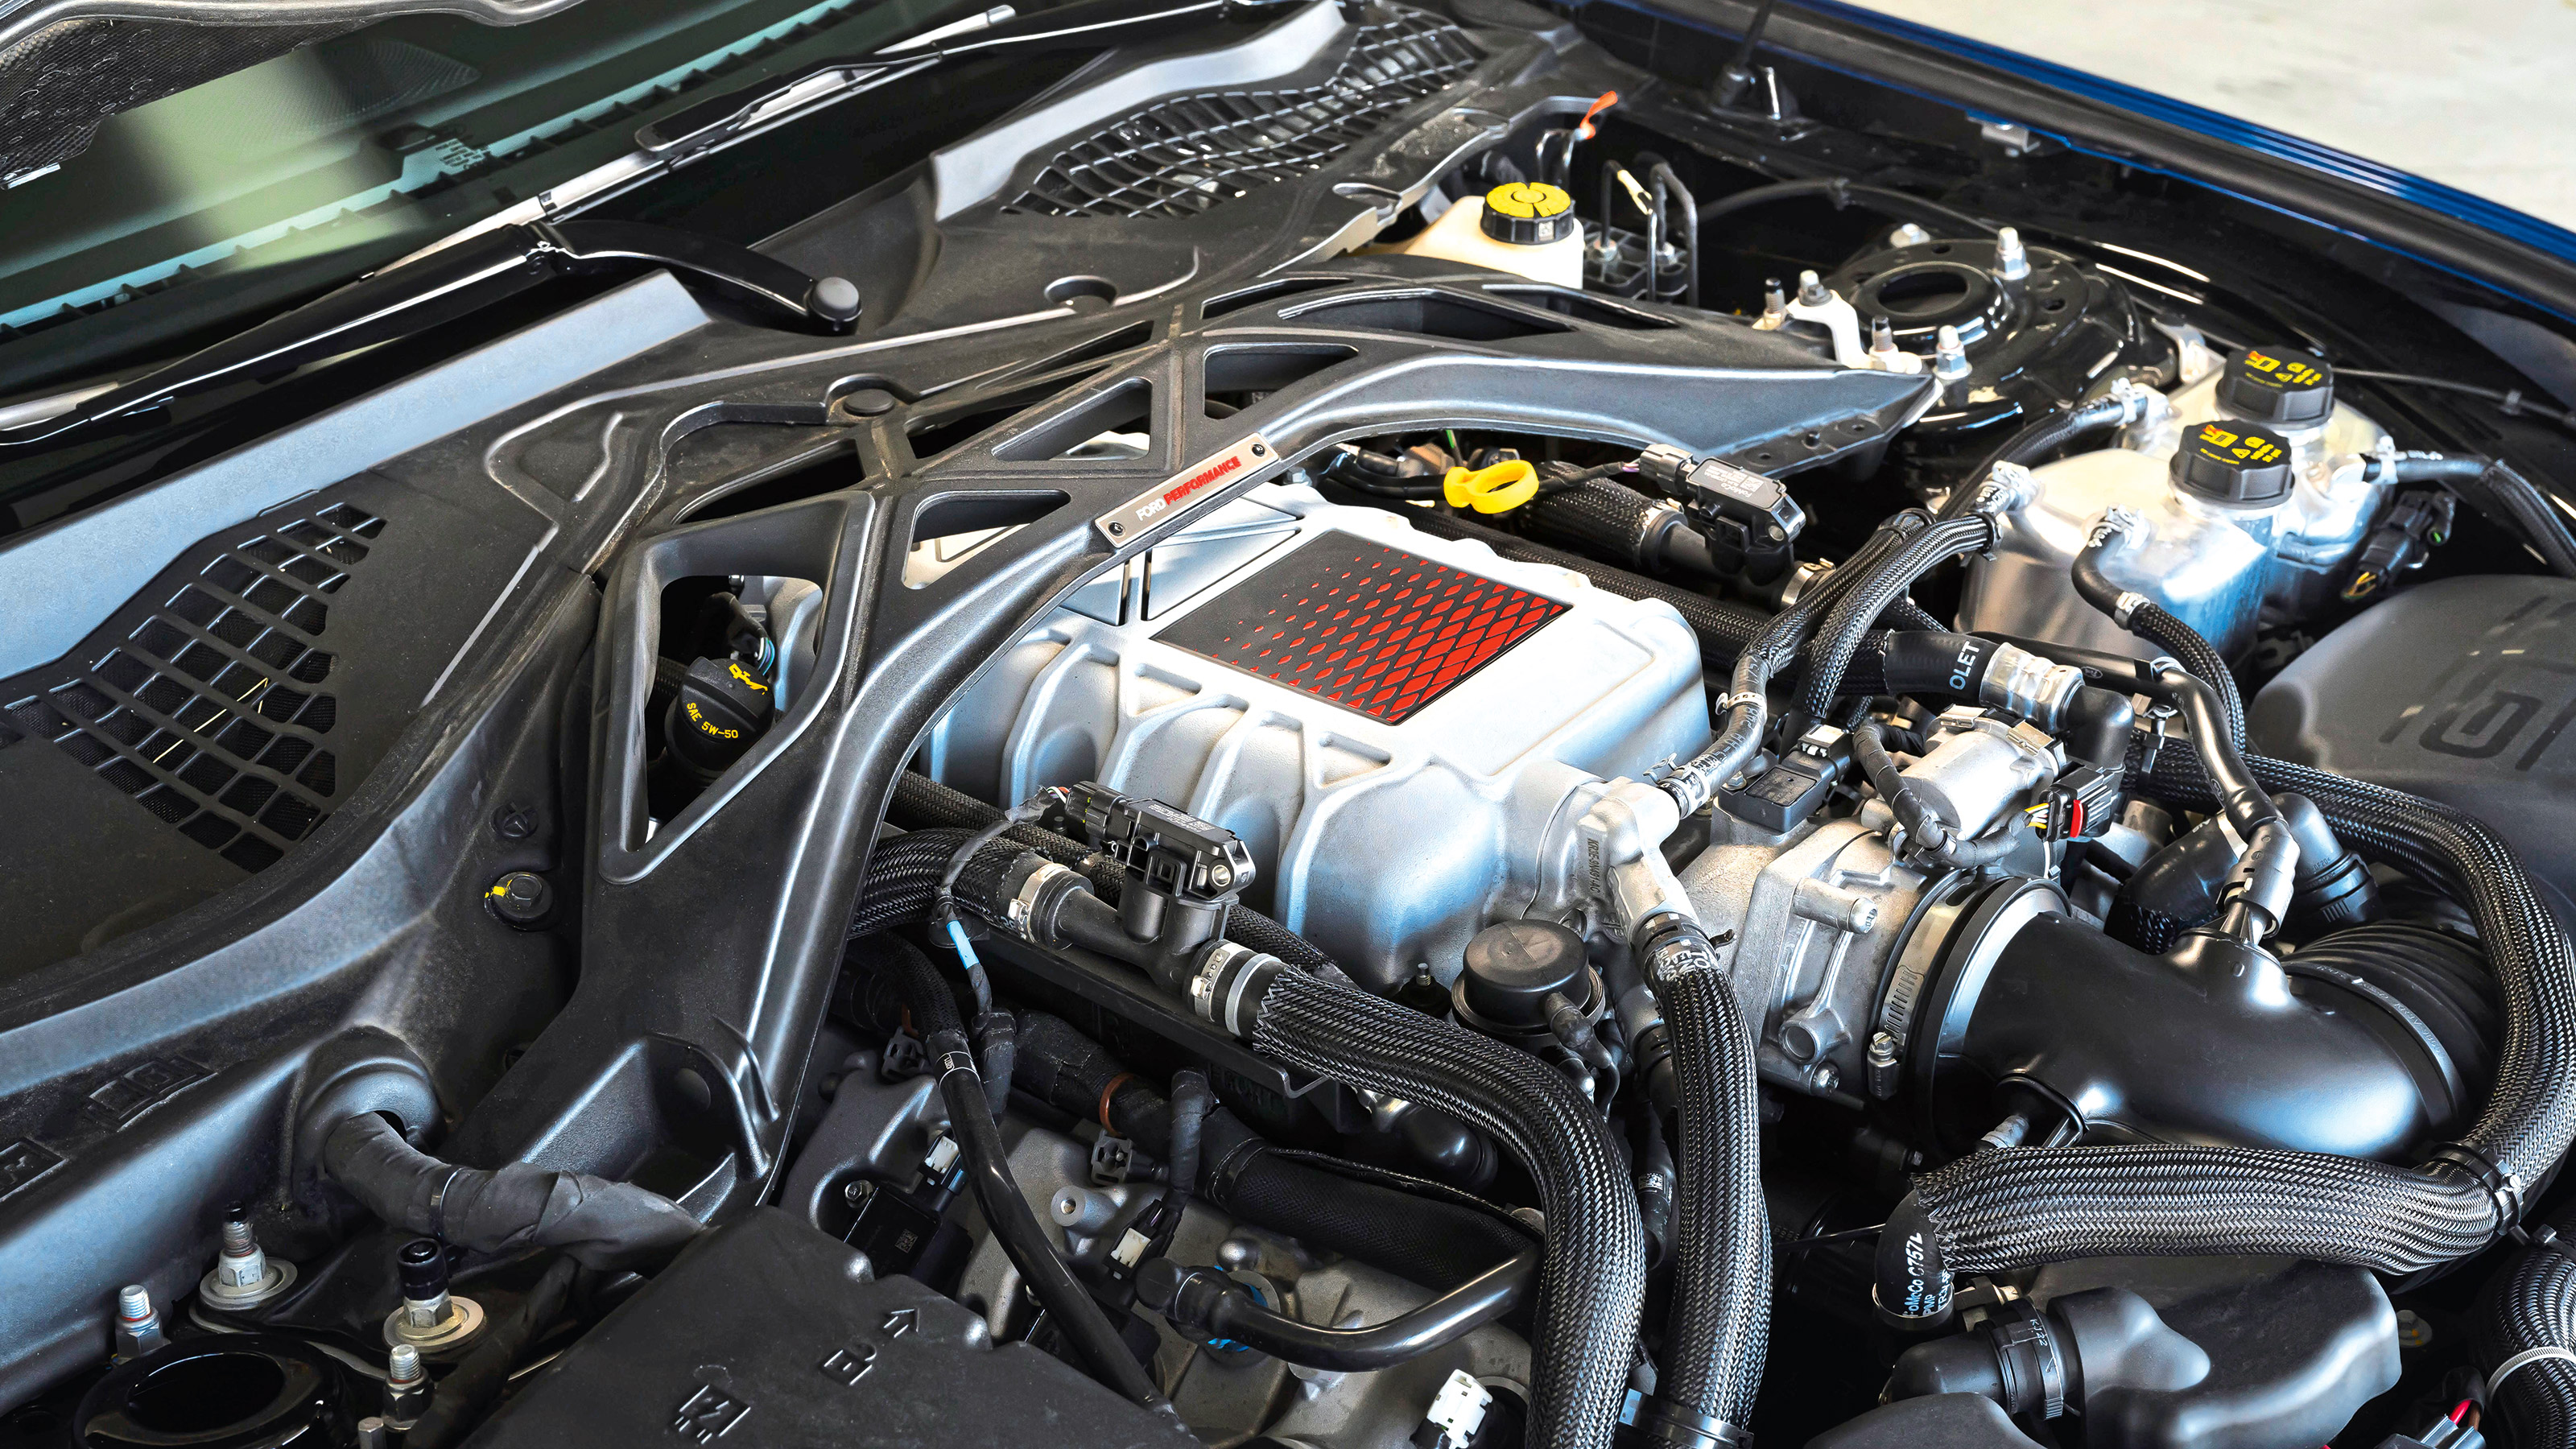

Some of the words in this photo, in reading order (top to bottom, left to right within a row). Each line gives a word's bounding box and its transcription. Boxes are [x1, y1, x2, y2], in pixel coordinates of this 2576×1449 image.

[1136, 497, 1166, 522] FORD
[1163, 456, 1242, 506] PERFORMANCE
[687, 703, 702, 721] SAE
[701, 721, 739, 738] 5W-50
[1905, 1232, 1924, 1276] C757L
